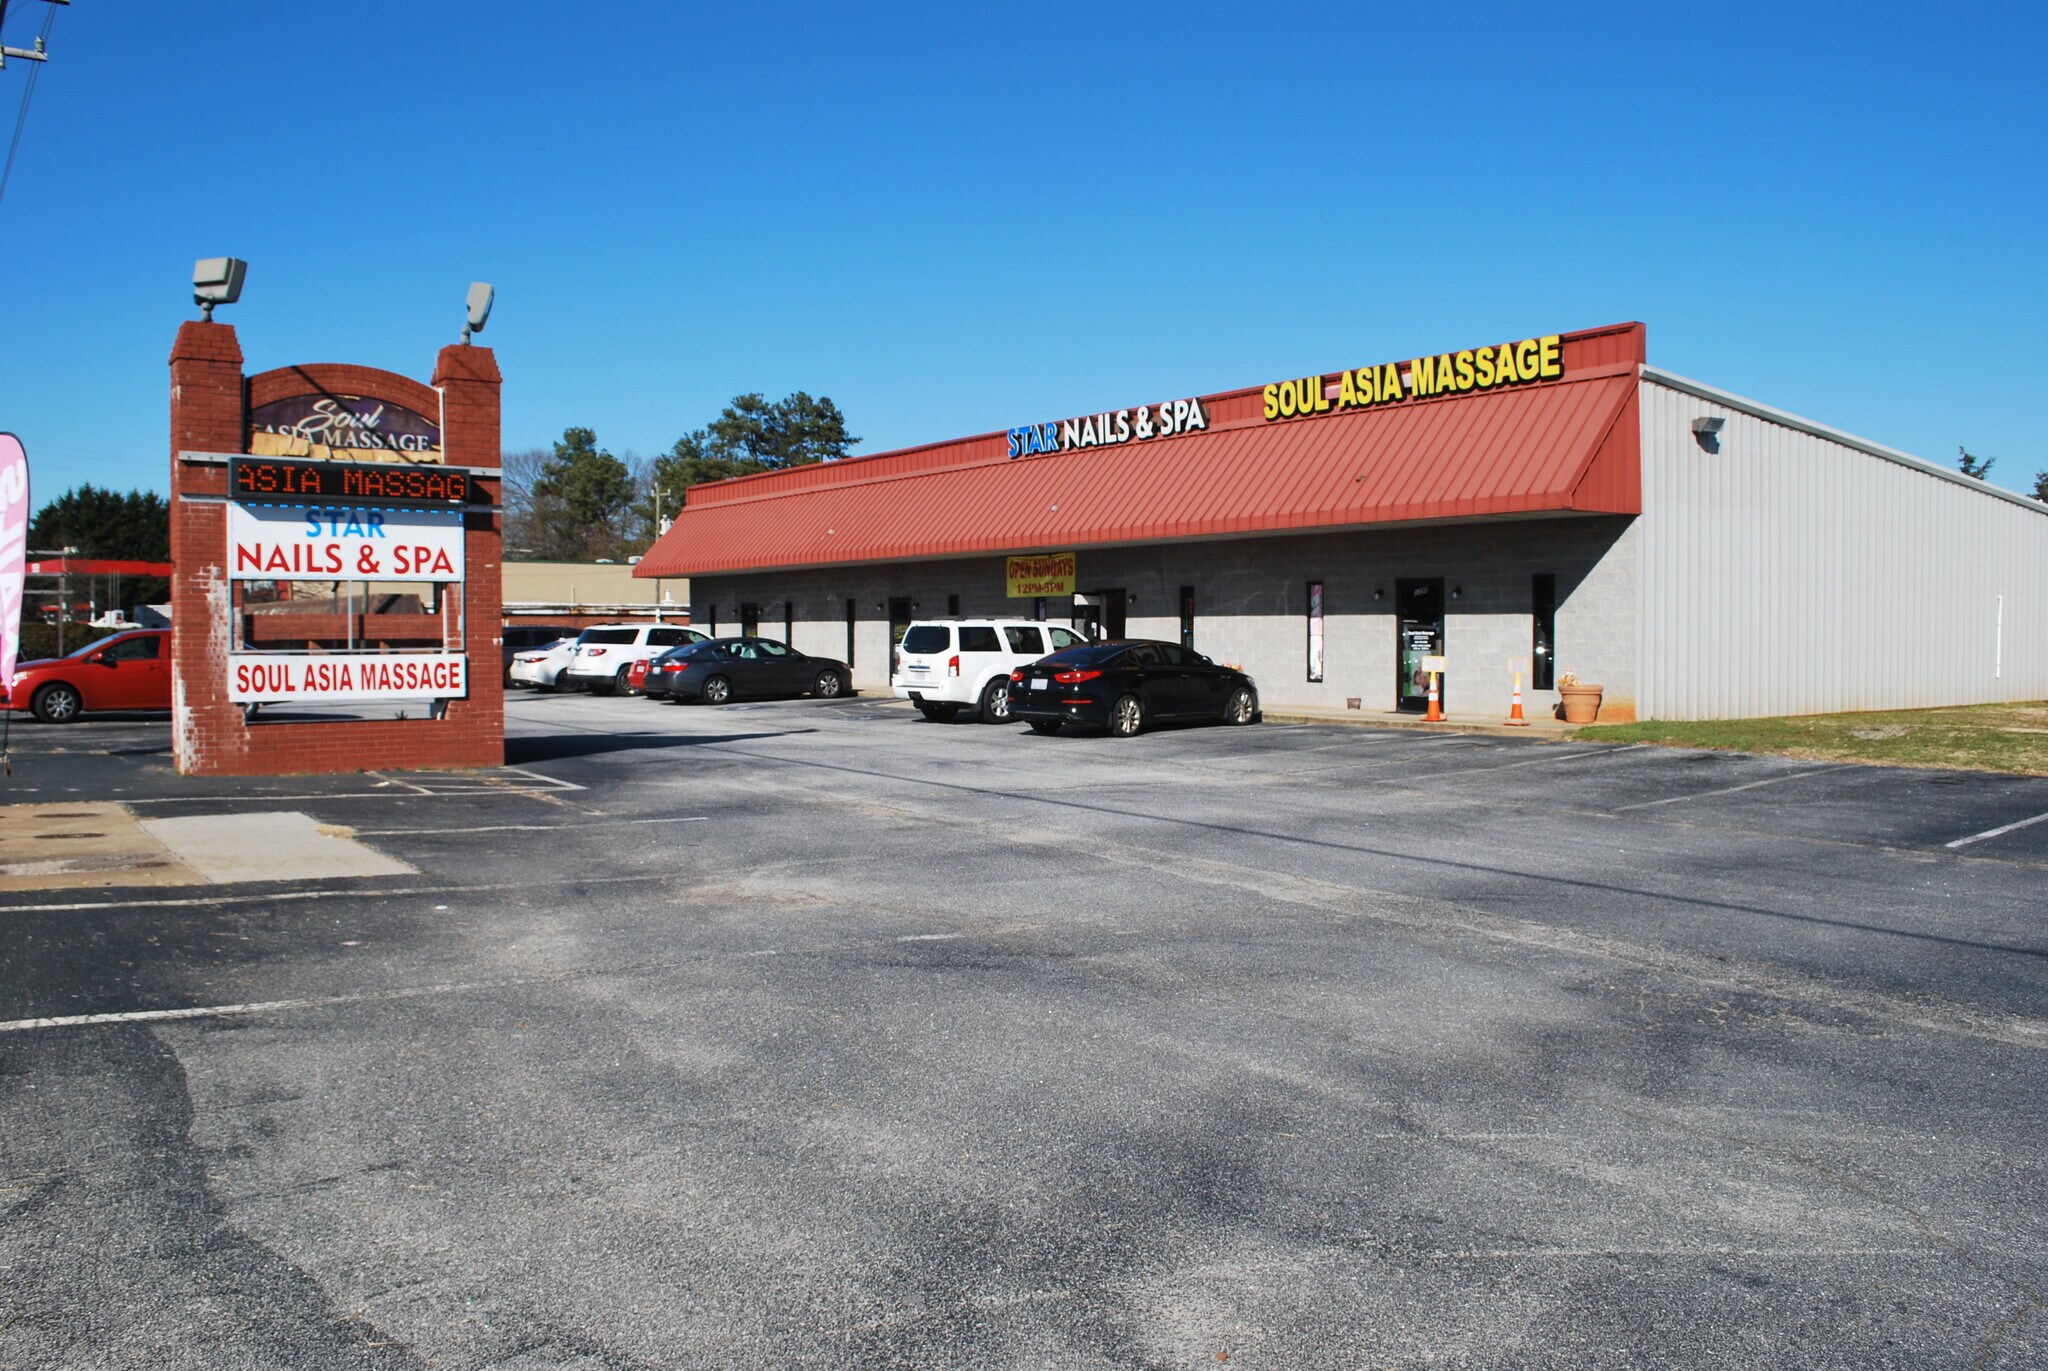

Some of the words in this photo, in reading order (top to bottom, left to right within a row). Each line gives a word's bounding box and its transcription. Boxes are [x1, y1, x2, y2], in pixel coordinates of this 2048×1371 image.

[1263, 375, 1329, 419] SOUL
[1338, 363, 1402, 407] ASIA
[1410, 335, 1560, 397] MASSAGE
[297, 399, 384, 432] Soul
[1007, 422, 1059, 458] STAR
[1064, 409, 1130, 449] NAILS
[1136, 406, 1153, 439] &
[1159, 397, 1206, 435] SPA
[322, 429, 430, 451] MASSAGE
[238, 464, 321, 493] ASIA
[343, 469, 465, 499] MASSAG
[305, 510, 386, 538] STAR
[237, 543, 343, 573] NAILS
[357, 544, 380, 574] &
[393, 545, 454, 574] SPA
[1009, 560, 1031, 579] OPEN
[1033, 557, 1074, 577] SUNDAYS
[1017, 582, 1064, 594] 12PM-5PM
[237, 664, 296, 693] SOUL
[303, 663, 353, 691] ASIA
[361, 662, 461, 690] MASSAGE
